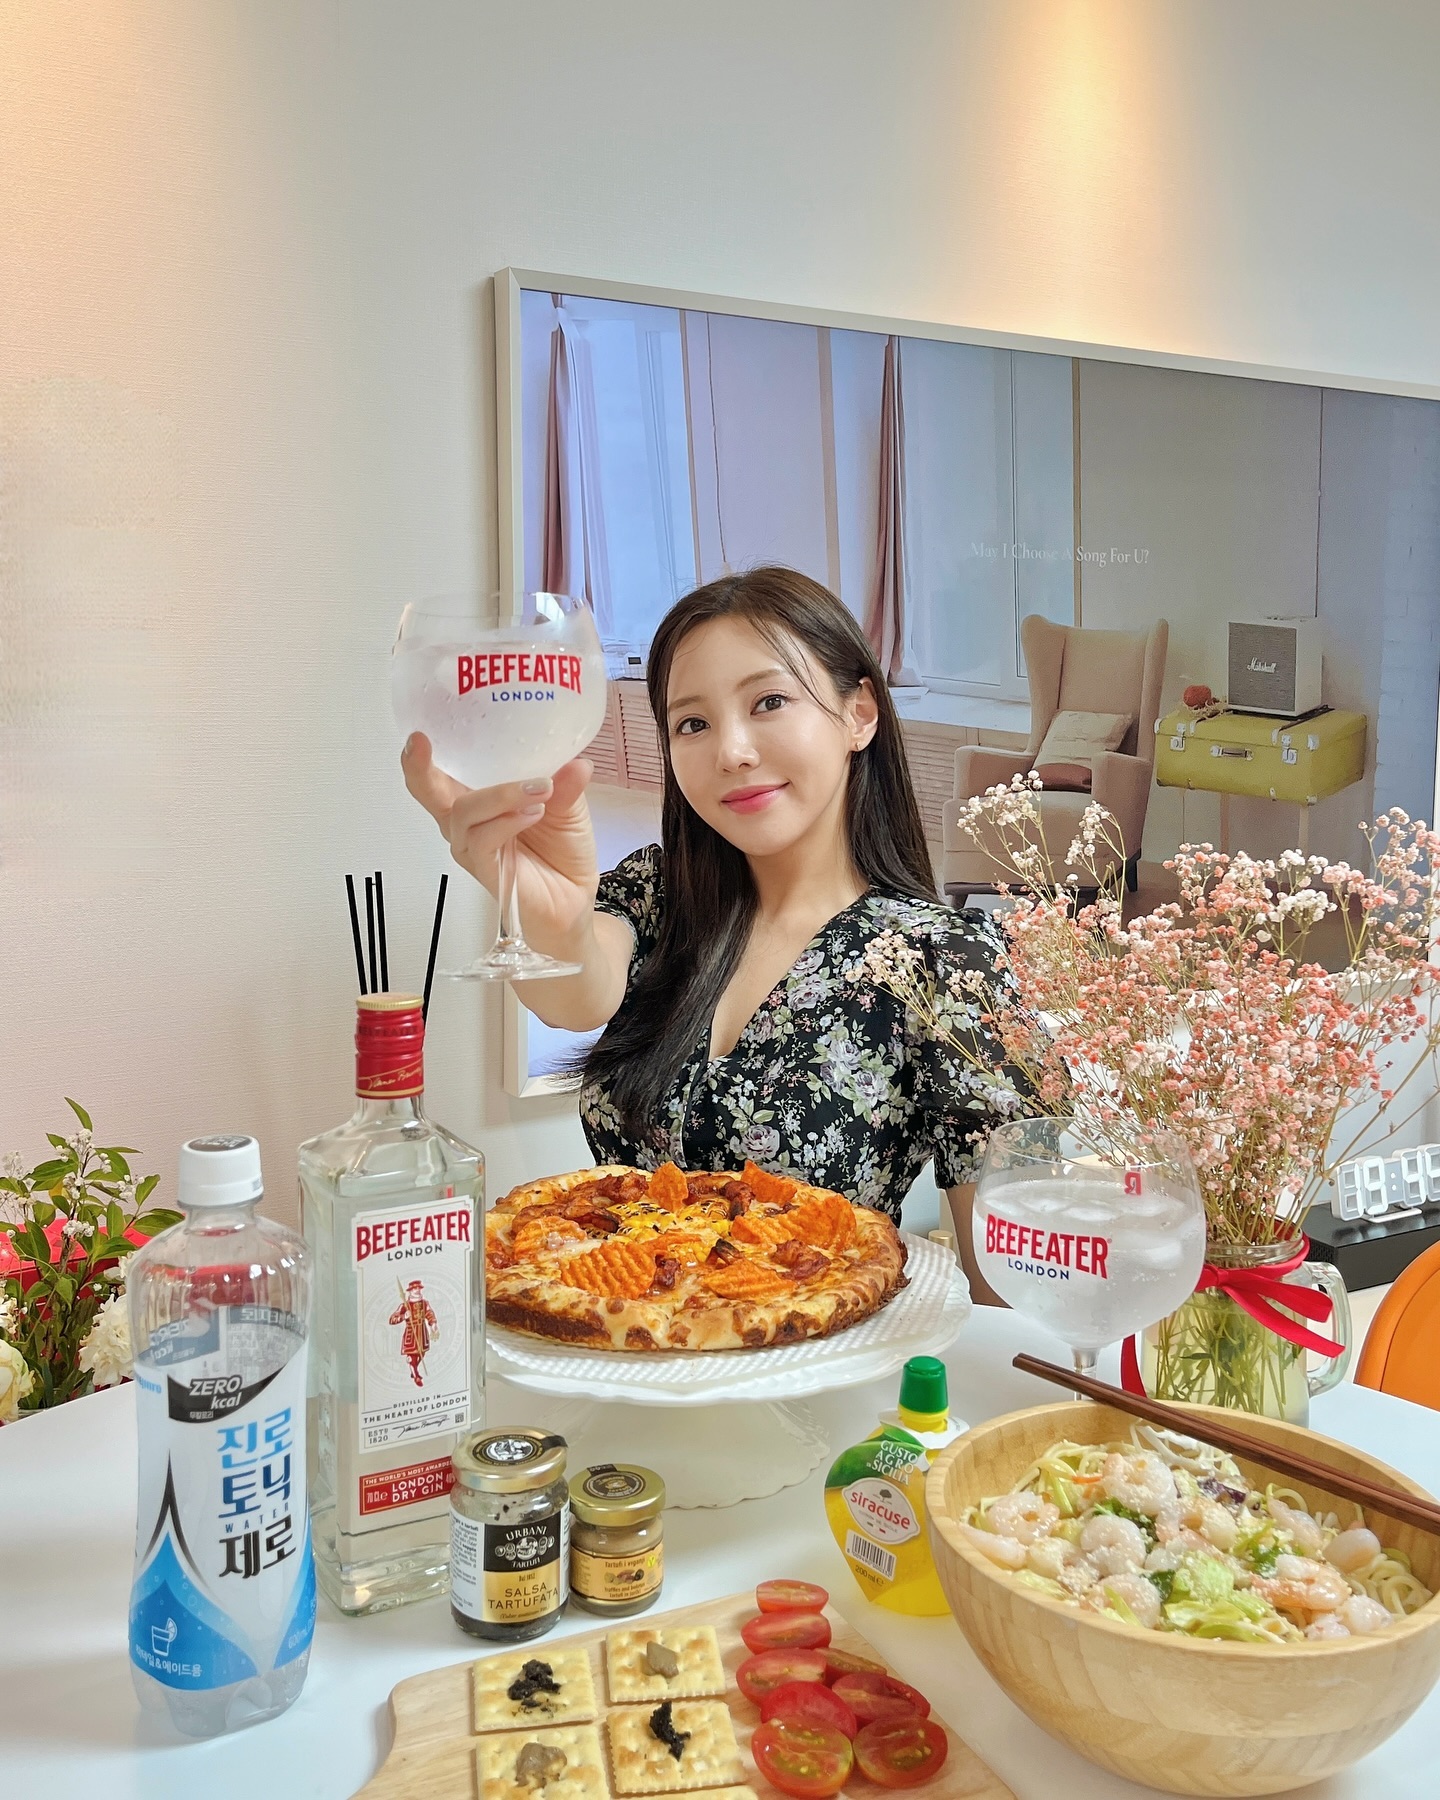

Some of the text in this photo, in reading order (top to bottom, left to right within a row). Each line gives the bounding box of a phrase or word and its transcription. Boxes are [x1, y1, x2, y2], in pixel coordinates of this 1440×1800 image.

[970, 542, 1150, 568] May I Choose A Song For U?
[457, 653, 582, 696] BEEFEATER
[491, 691, 554, 702] LONDON
[356, 1209, 470, 1262] BEEFEATER
[985, 1213, 1109, 1279] BEEFEATER
[387, 1244, 442, 1261] LONDON
[1008, 1257, 1070, 1280] LONDON
[189, 1375, 242, 1396] ZERO
[211, 1392, 242, 1410] kcal
[364, 1396, 467, 1424] THE HEART OF LONDON
[393, 1396, 430, 1408] DISTILLED
[217, 1407, 293, 1469] 진로
[369, 1436, 388, 1444] 1820
[875, 1450, 914, 1474] AGRO
[880, 1440, 918, 1464] GUSTO
[379, 1472, 406, 1482] WORLD'S
[408, 1467, 424, 1476] MOST
[392, 1472, 443, 1493] LONDON
[871, 1460, 909, 1485] SICILIA
[218, 1453, 291, 1518] 토닉
[392, 1482, 443, 1503] DRY GIN
[225, 1502, 289, 1533] WATER
[850, 1491, 911, 1530] siracuse
[505, 1525, 547, 1541] URBANI
[218, 1514, 296, 1579] 제로
[512, 1557, 541, 1568] TARTUFI
[855, 1565, 868, 1577] 200
[868, 1574, 875, 1583] ml
[488, 1587, 559, 1609] TARTUFATA
[505, 1582, 547, 1598] SALSA
